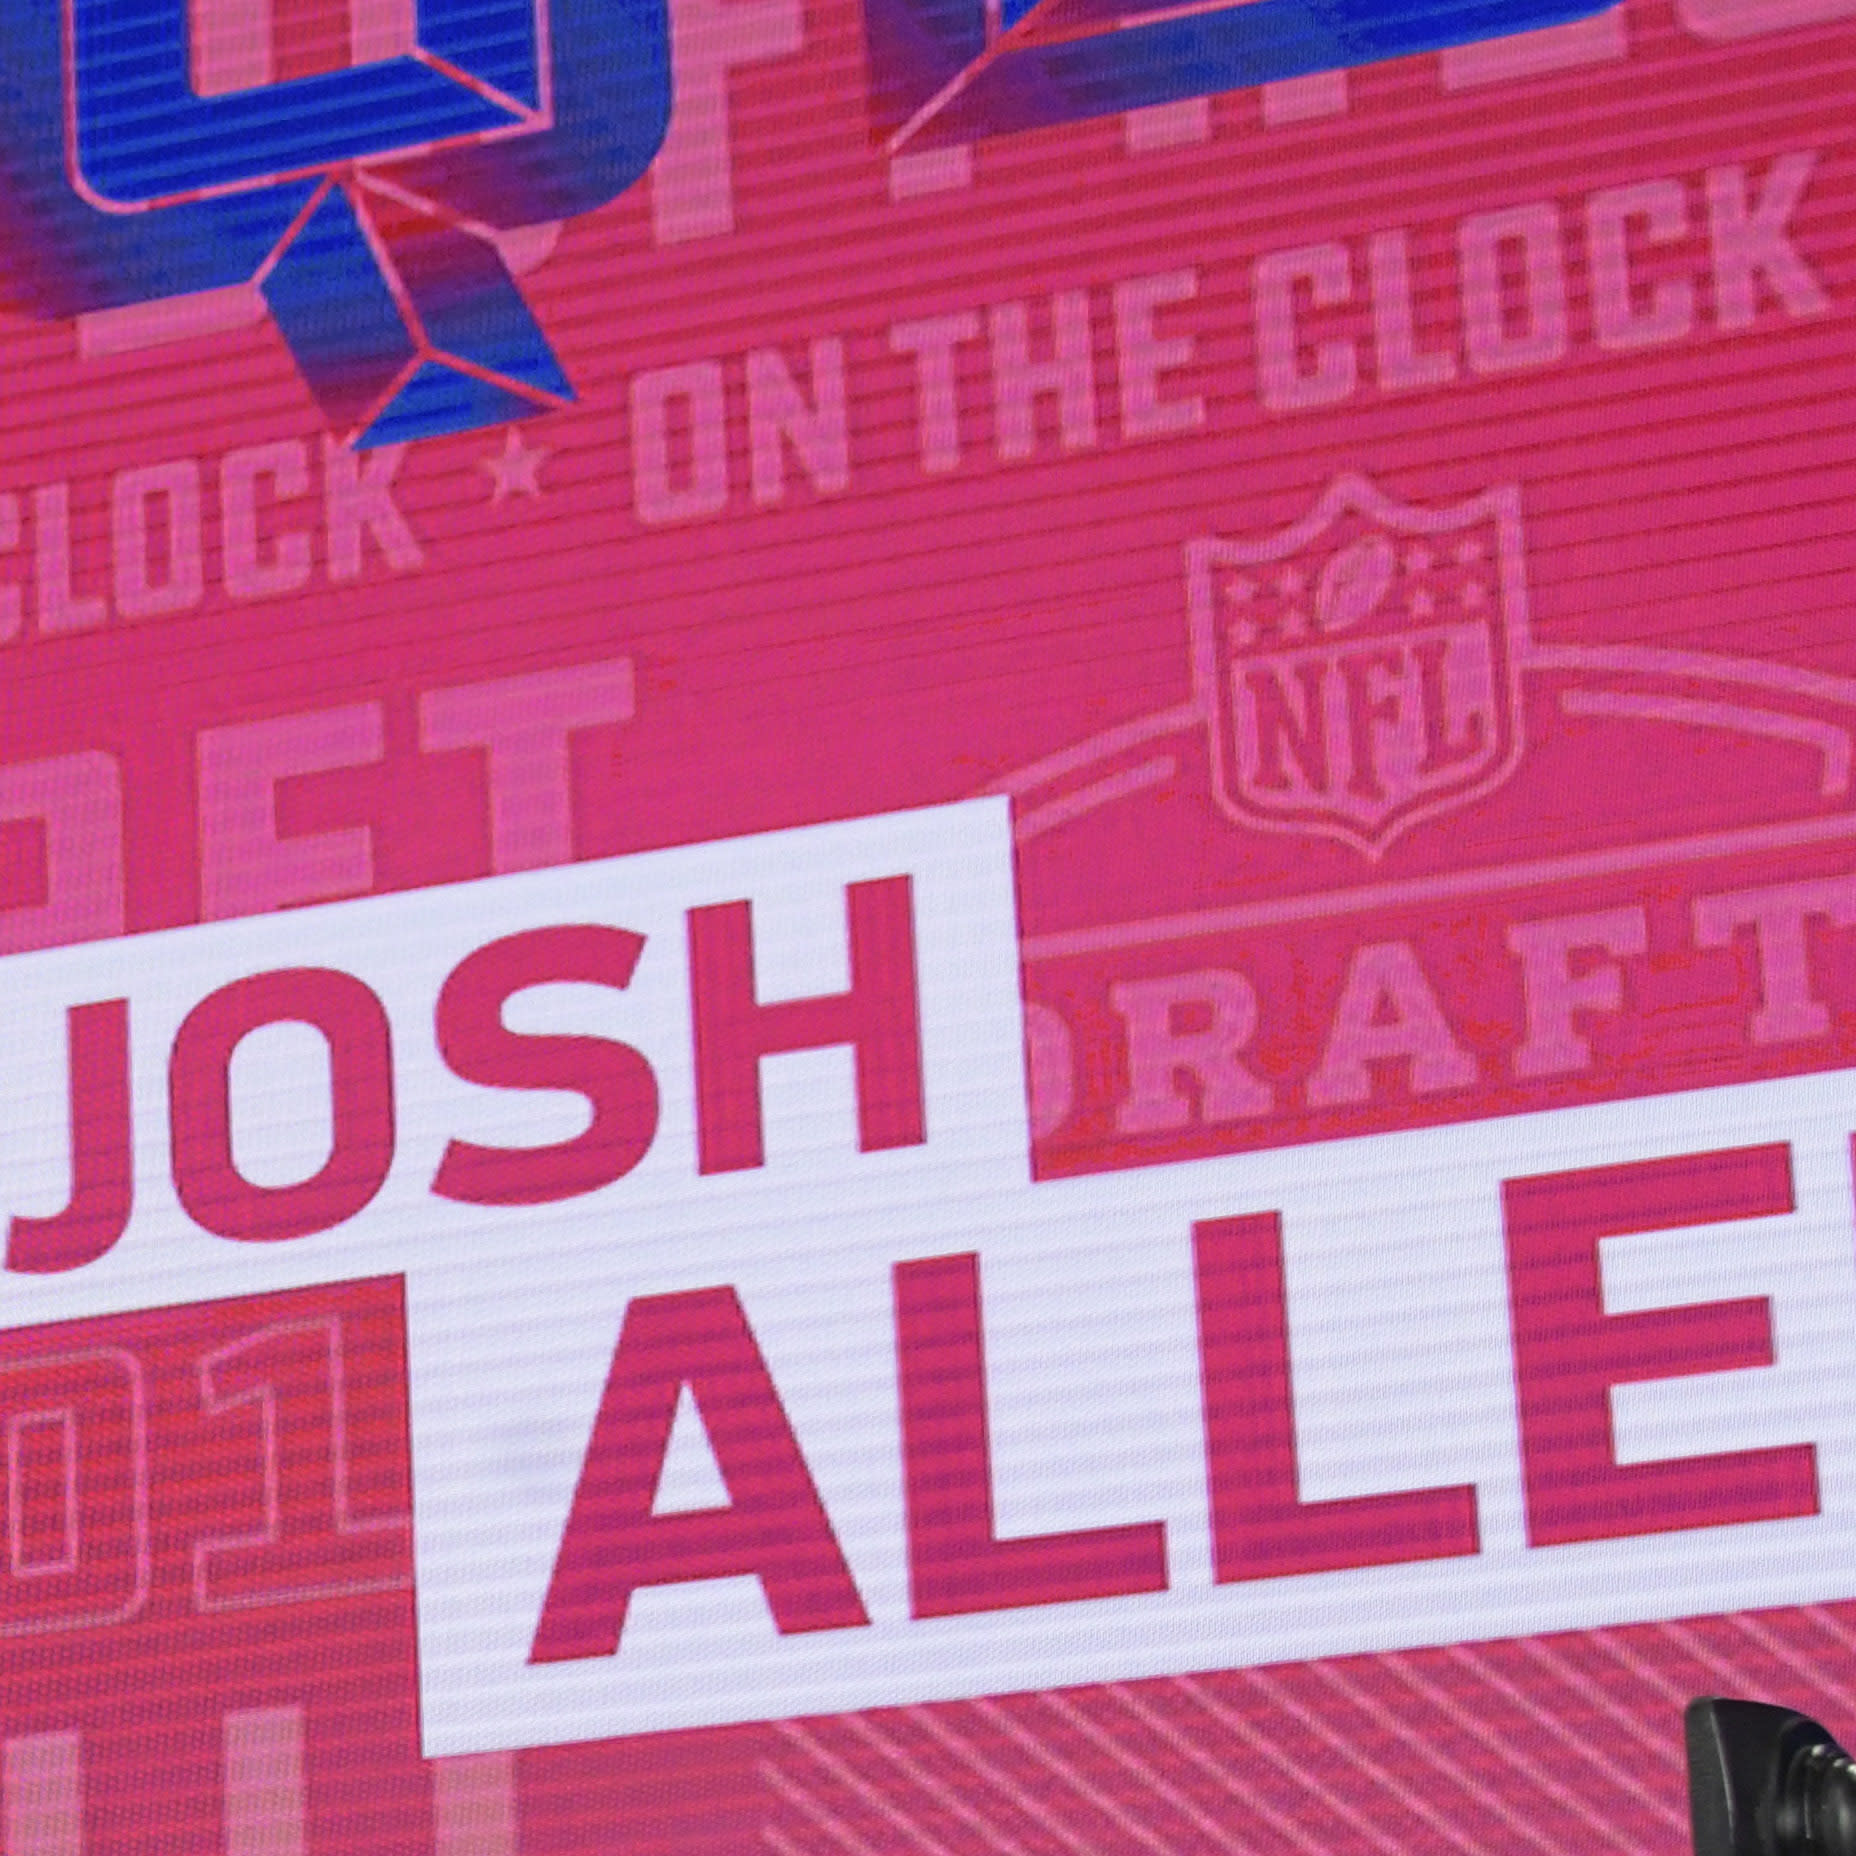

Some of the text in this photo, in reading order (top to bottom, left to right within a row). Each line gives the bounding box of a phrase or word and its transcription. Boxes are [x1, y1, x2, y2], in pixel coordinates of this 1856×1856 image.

[628, 336, 850, 525] ON
[889, 268, 1205, 473] THE
[1254, 150, 1829, 411] CLOCK
[1243, 640, 1486, 804] NFL
[2, 872, 928, 1275] JOSH
[526, 1134, 1856, 1665] ALLE
